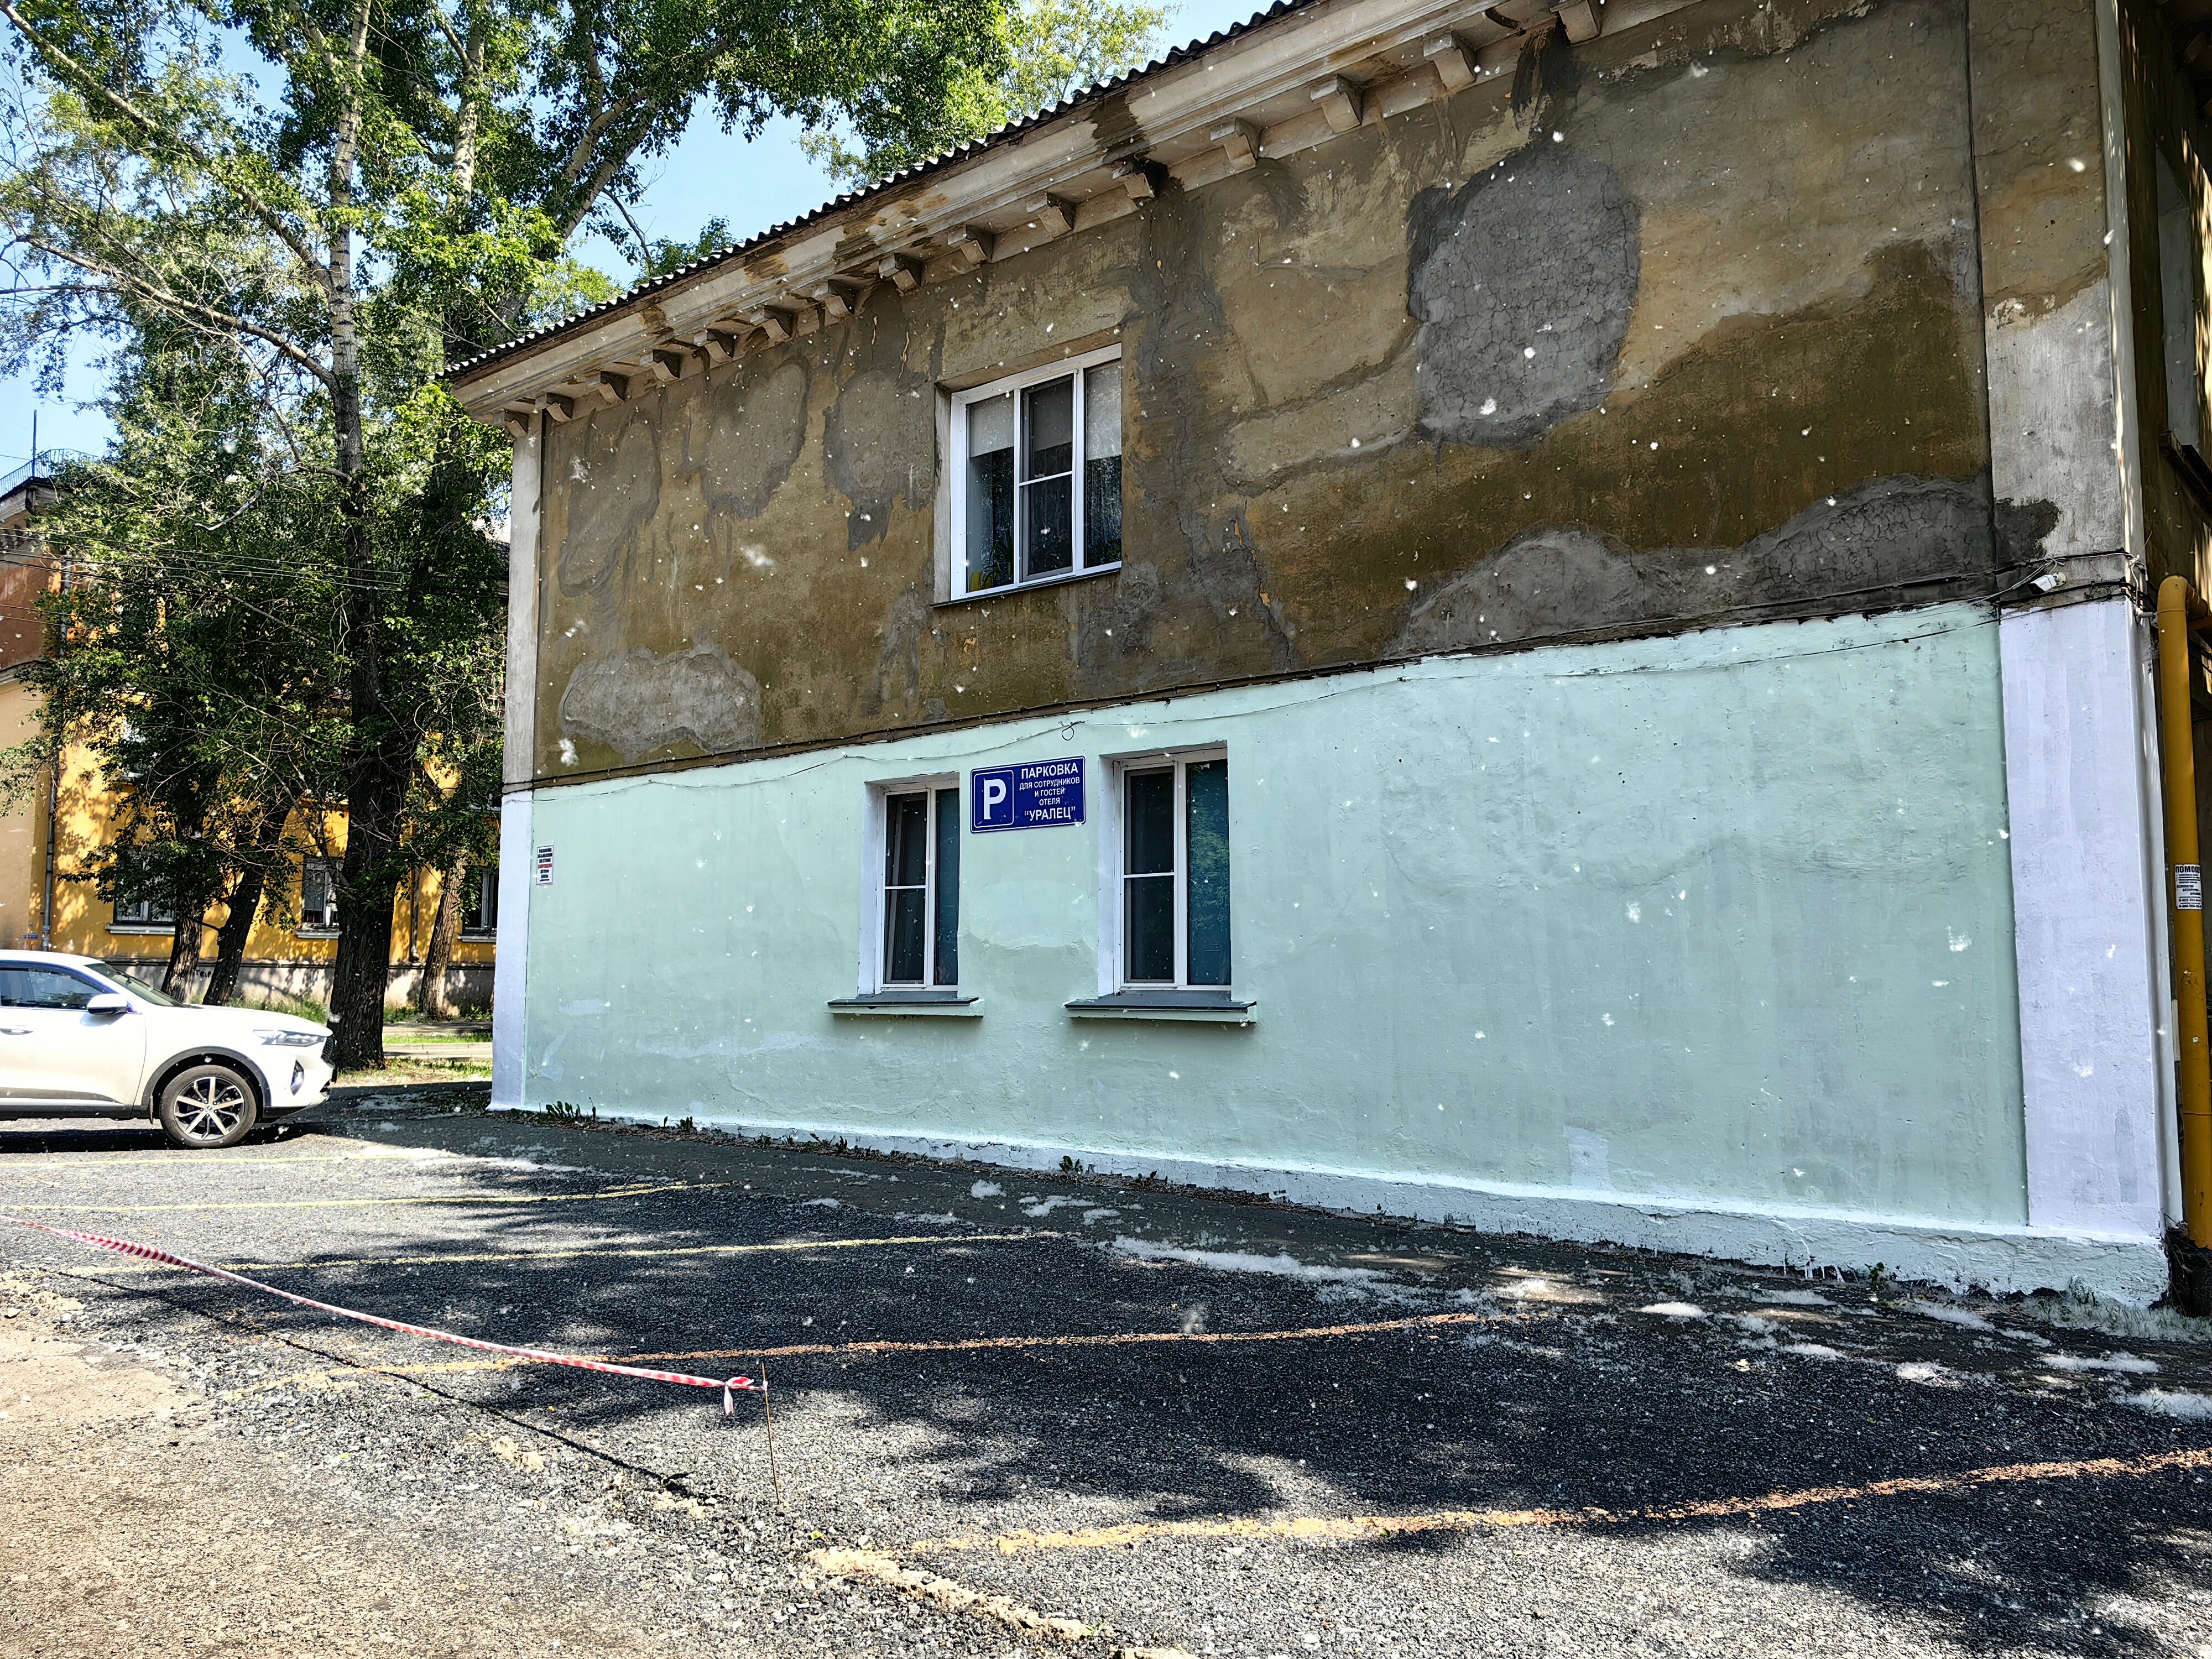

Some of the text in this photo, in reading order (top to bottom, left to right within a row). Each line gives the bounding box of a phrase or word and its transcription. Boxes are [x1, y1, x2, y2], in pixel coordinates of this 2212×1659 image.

[1021, 762, 1078, 779] ПАРКОВКА
[1019, 776, 1080, 791] ДЛЯ СОТРУДНИКОВ
[1040, 787, 1065, 796] ГОСТЕЙ
[983, 779, 1006, 820] P
[1039, 797, 1060, 806] ОТЕЛЯ
[195, 969, 212, 978] TRIP
